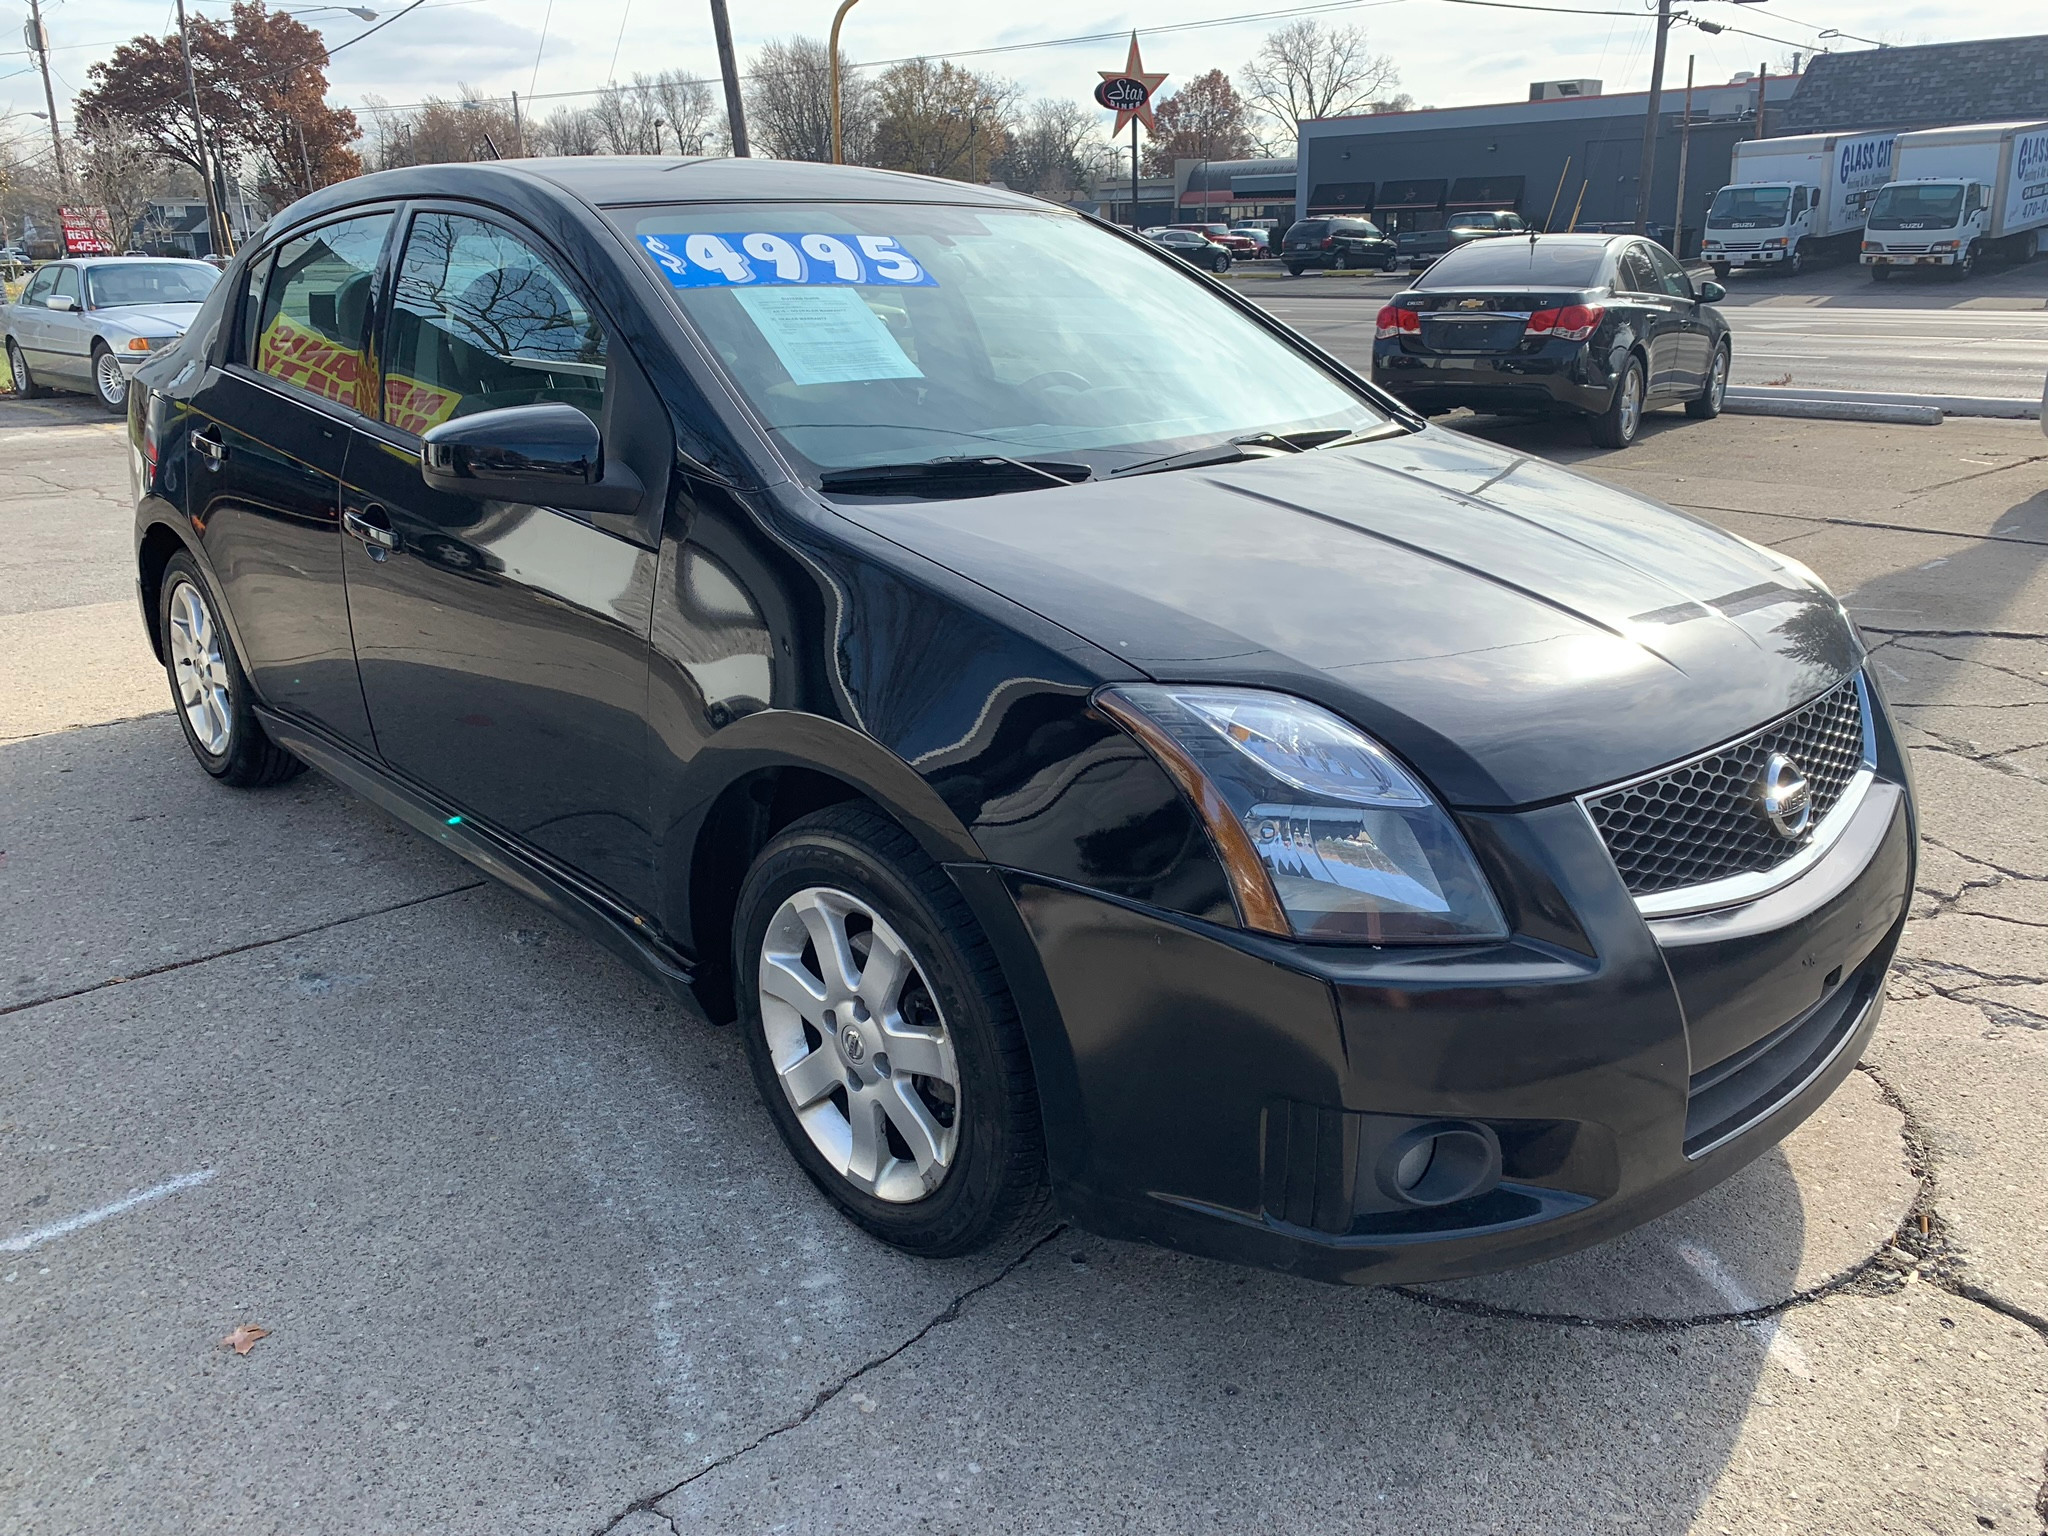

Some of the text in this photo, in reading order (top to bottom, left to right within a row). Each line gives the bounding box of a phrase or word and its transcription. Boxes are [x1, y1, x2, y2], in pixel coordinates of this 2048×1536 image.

[1108, 79, 1144, 100] Star
[1110, 100, 1141, 110] DINER
[1841, 143, 1875, 184] GLASS
[1877, 139, 1894, 168] CIT
